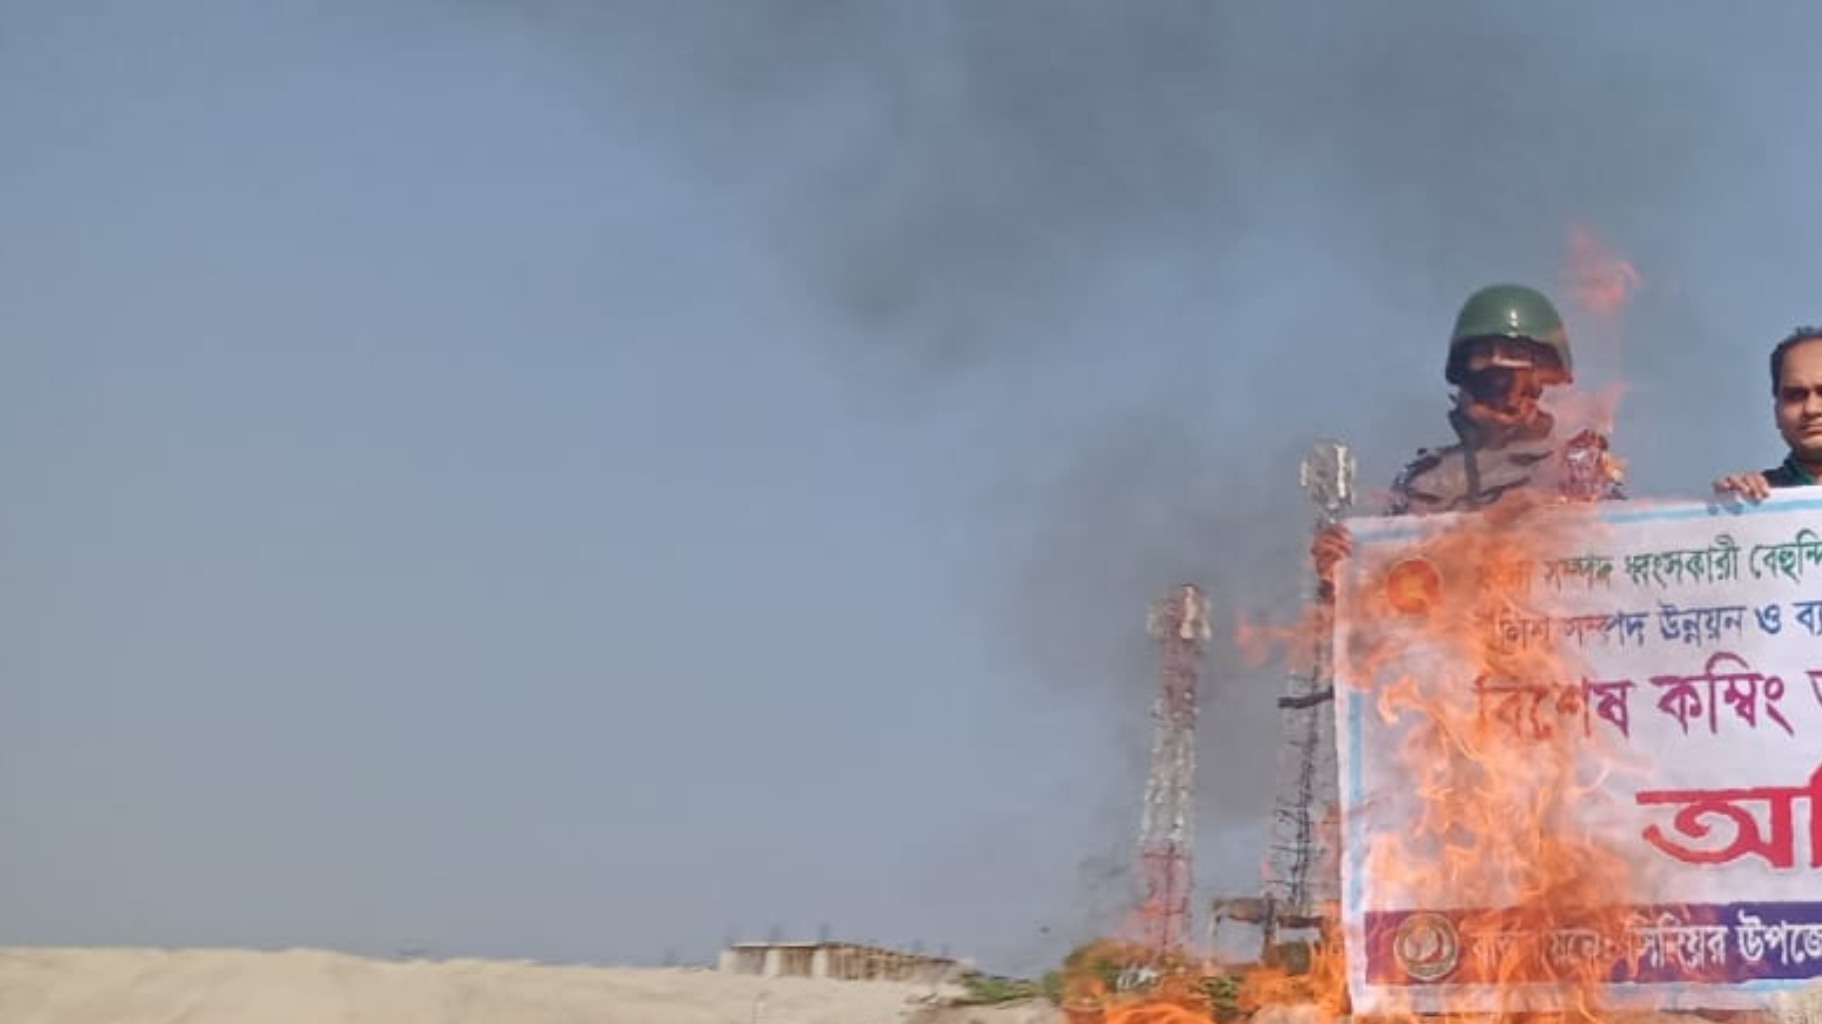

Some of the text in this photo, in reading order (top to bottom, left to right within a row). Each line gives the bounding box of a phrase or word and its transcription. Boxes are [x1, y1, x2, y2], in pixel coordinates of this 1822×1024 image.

[1625, 534, 1740, 588] ধ্বংসকারী
[1658, 601, 1747, 648] উন্নয়ন
[1755, 604, 1782, 635] ও
[1650, 651, 1794, 737] কম্বিং
